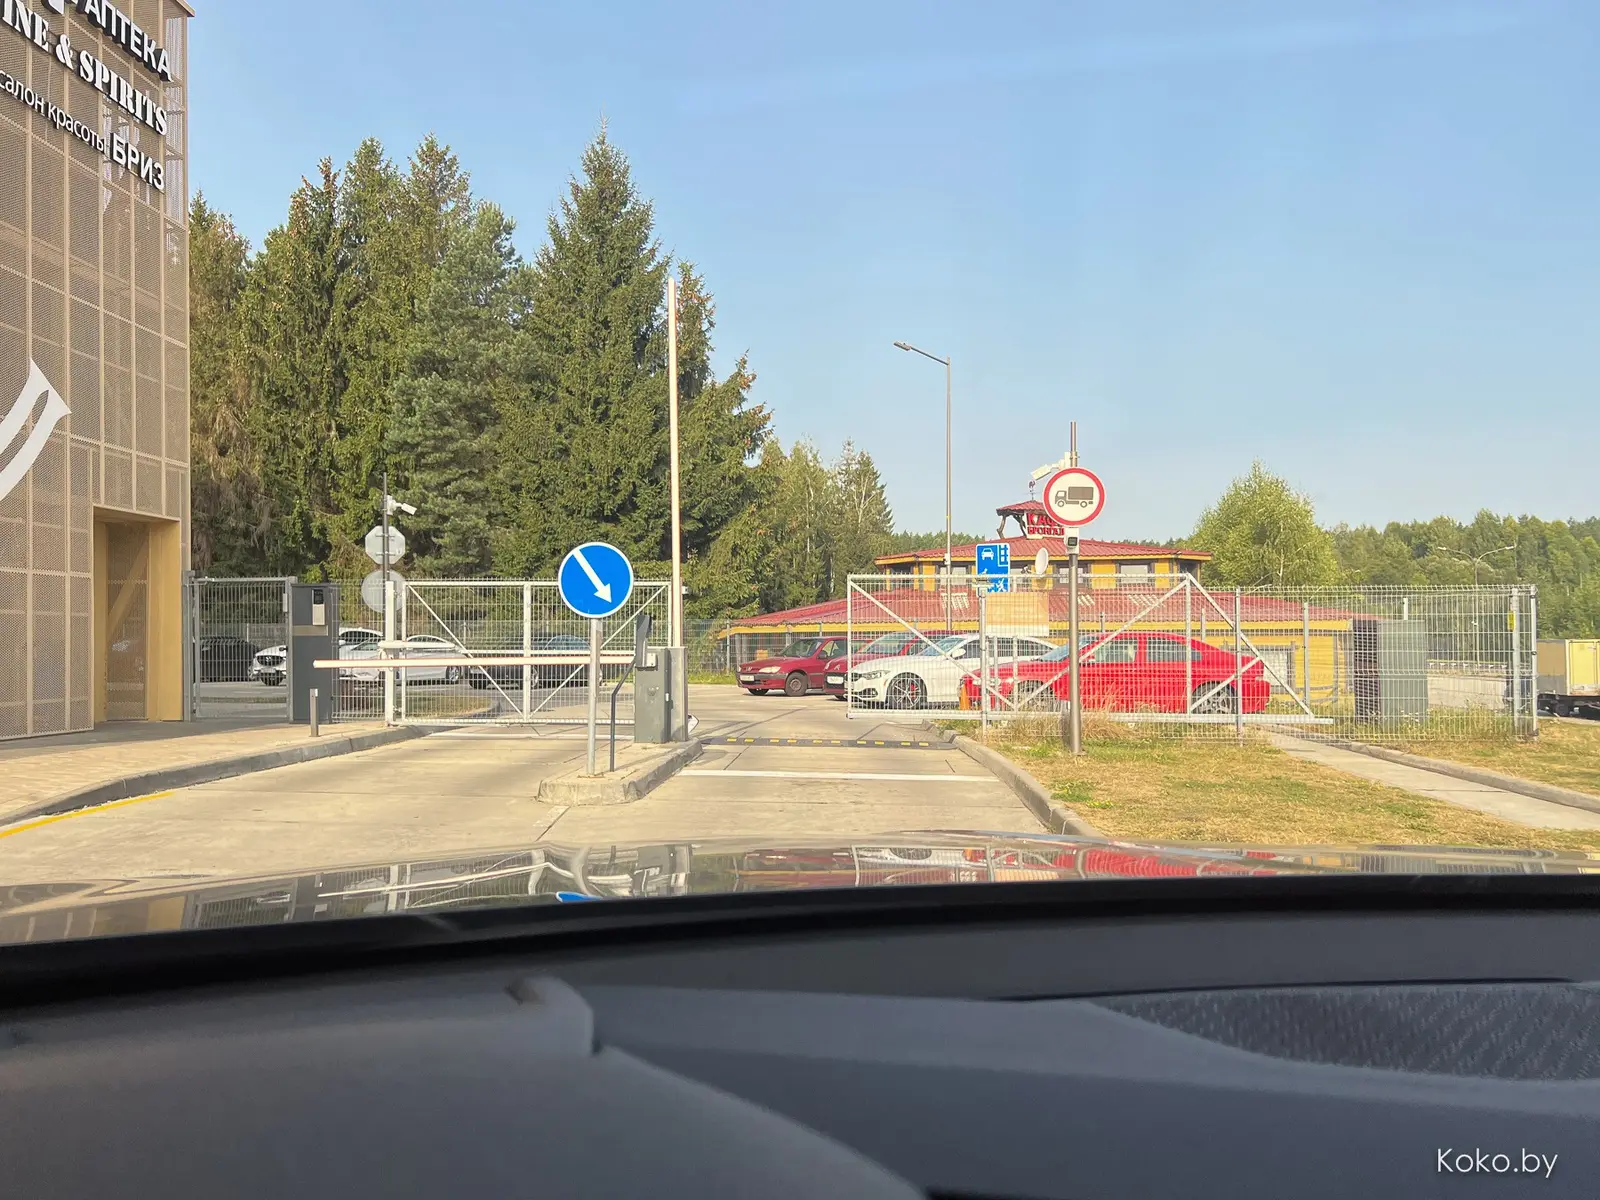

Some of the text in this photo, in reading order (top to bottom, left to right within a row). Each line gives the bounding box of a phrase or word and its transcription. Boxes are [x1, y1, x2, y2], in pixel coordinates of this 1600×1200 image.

[84, 0, 173, 81] АПТЕКА
[0, 70, 106, 154] салон красоты
[55, 33, 74, 70] &
[79, 50, 168, 136] SPIRITS
[112, 132, 165, 191] БРИЗ
[1026, 513, 1060, 527] КАФ
